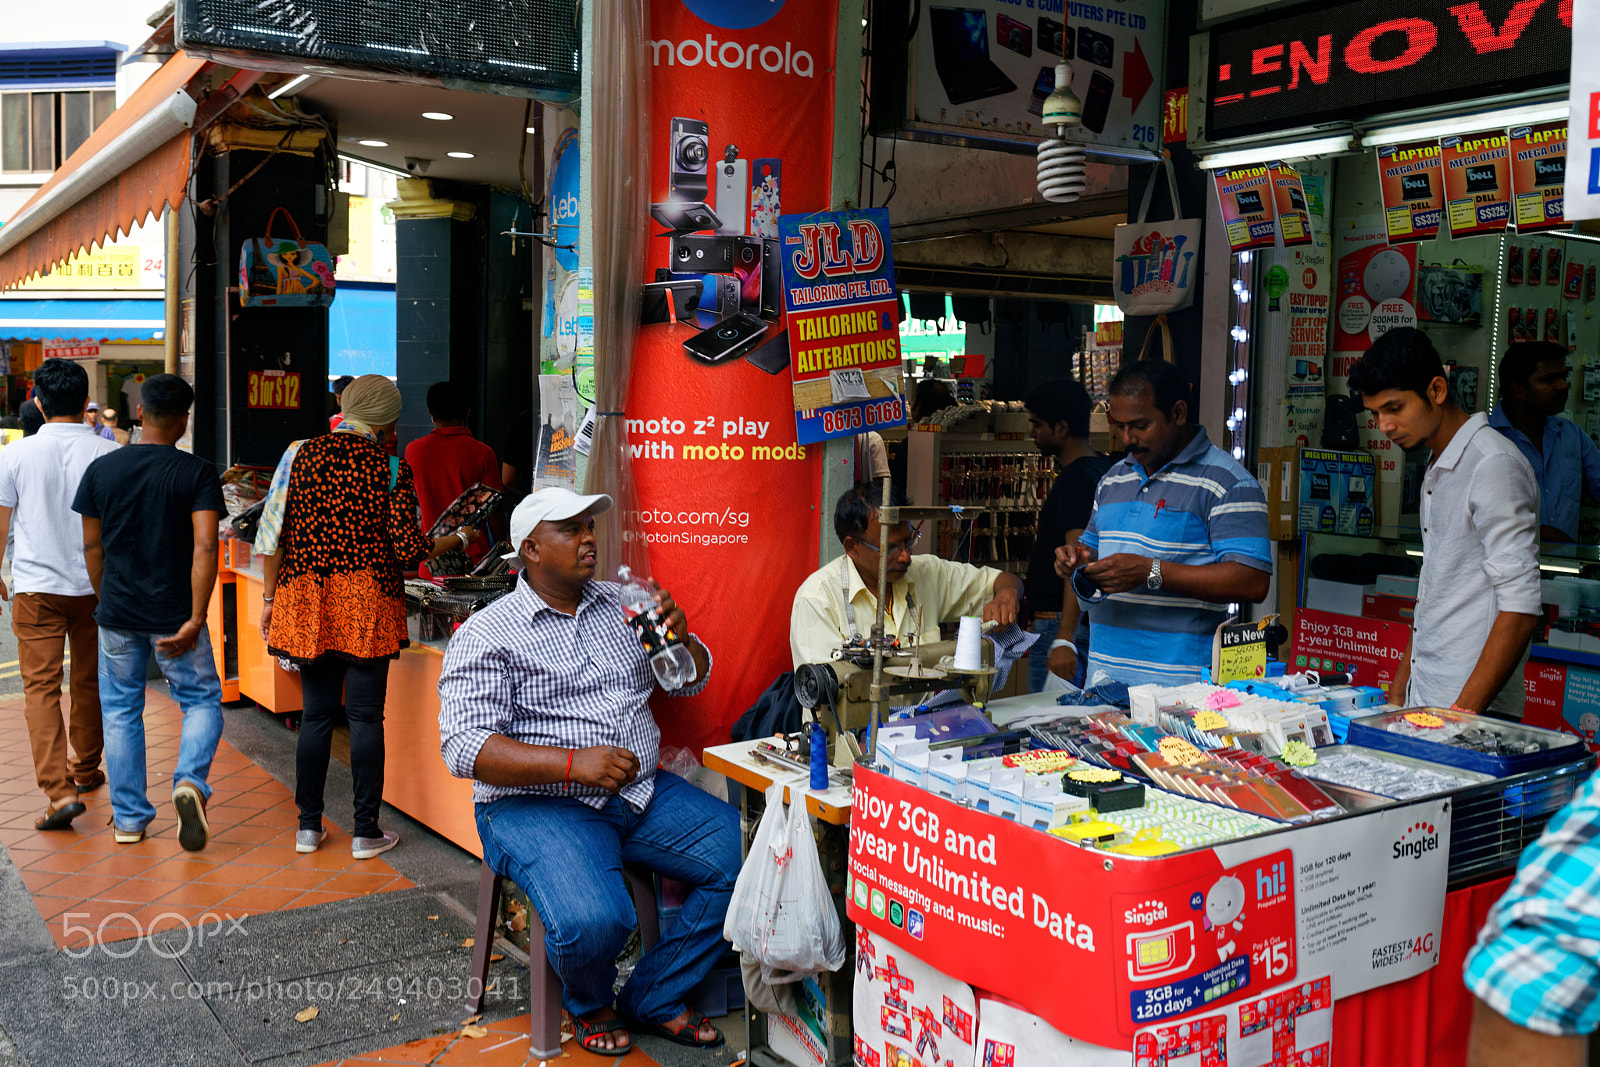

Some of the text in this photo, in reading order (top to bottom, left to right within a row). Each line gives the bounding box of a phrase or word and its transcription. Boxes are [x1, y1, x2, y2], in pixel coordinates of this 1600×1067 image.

[1106, 10, 1126, 26] PTE
[1128, 14, 1146, 30] LTD
[648, 33, 814, 78] motorola
[1132, 124, 1155, 143] 216
[1456, 136, 1508, 153] LAPTOP
[1392, 146, 1440, 162] LAPTOP
[1449, 148, 1507, 169] MEGA OFFER
[1517, 147, 1547, 161] MEGA
[1225, 167, 1266, 181] LAPTOP
[1386, 157, 1440, 178] MEGA OFFER
[1405, 179, 1428, 189] DELL
[1469, 171, 1493, 181] DELL
[1222, 183, 1245, 194] MEGA
[1411, 202, 1430, 210] DELL
[1476, 194, 1496, 203] DELL
[1247, 214, 1264, 222] DELL
[1343, 234, 1364, 242] Prepaid
[793, 219, 884, 279] JLD
[791, 278, 892, 306] TAILORING PTE. LTD.
[1290, 293, 1328, 307] EASY TOPUP
[1381, 304, 1404, 313] FREE
[796, 310, 893, 343] TAILORING &
[1291, 317, 1327, 327] LAPTOP
[1372, 315, 1399, 324] 500MB
[1401, 315, 1414, 323] for
[1290, 327, 1325, 342] SERVICE
[1376, 324, 1387, 333] 30
[797, 338, 898, 374] ALTERATIONS
[1290, 344, 1326, 356] DONE HERE
[249, 373, 259, 406] 3
[260, 375, 275, 407] for
[823, 407, 862, 434] 8673
[864, 400, 903, 426] 6168
[625, 416, 686, 435] moto
[722, 416, 770, 439] play
[629, 440, 807, 461] with moto mods
[1367, 440, 1391, 450] $8.50
[1304, 451, 1337, 461] MEGA OFFER
[1242, 629, 1265, 642] New
[1300, 619, 1378, 642] Enjoy 3GB and
[1299, 632, 1333, 646] 1-year
[1336, 638, 1387, 658] Unlimited
[1323, 649, 1351, 660] messaging
[1539, 670, 1562, 681] Singtel
[1570, 673, 1581, 683] Say
[1569, 688, 1585, 697] every
[1570, 682, 1594, 692] rewards
[1543, 698, 1556, 707] tea
[1568, 694, 1590, 704] Singtel
[1009, 750, 1068, 763] Hot Item
[898, 800, 940, 843] 3GB
[944, 828, 997, 866] and
[1393, 833, 1438, 859] Singtel
[1300, 851, 1352, 875] 3GB for 120 days
[1256, 860, 1287, 901] hi!
[853, 859, 877, 882] social
[878, 868, 931, 913] messaging
[932, 901, 955, 922] and
[957, 910, 1005, 939] music:
[903, 841, 1025, 919] Unlimited
[1032, 893, 1096, 953] Data
[1191, 896, 1202, 906] 4G
[1257, 895, 1287, 910] Prepaid SIM
[1301, 897, 1331, 916] Unlimited
[1332, 893, 1347, 904] Data
[1347, 889, 1356, 898] for
[1362, 881, 1377, 892] year:
[1124, 906, 1169, 926] Singtel
[1252, 942, 1263, 952] Pay
[1269, 936, 1281, 946] Get
[1412, 932, 1434, 957] 4G
[1252, 941, 1289, 980] $15
[1372, 953, 1404, 970] WIDEST
[1203, 958, 1245, 981] Unlimited Data
[1211, 976, 1221, 985] for
[1225, 969, 1237, 981] year
[1145, 985, 1185, 1003] 3GB for
[1136, 996, 1193, 1020] 120 days
